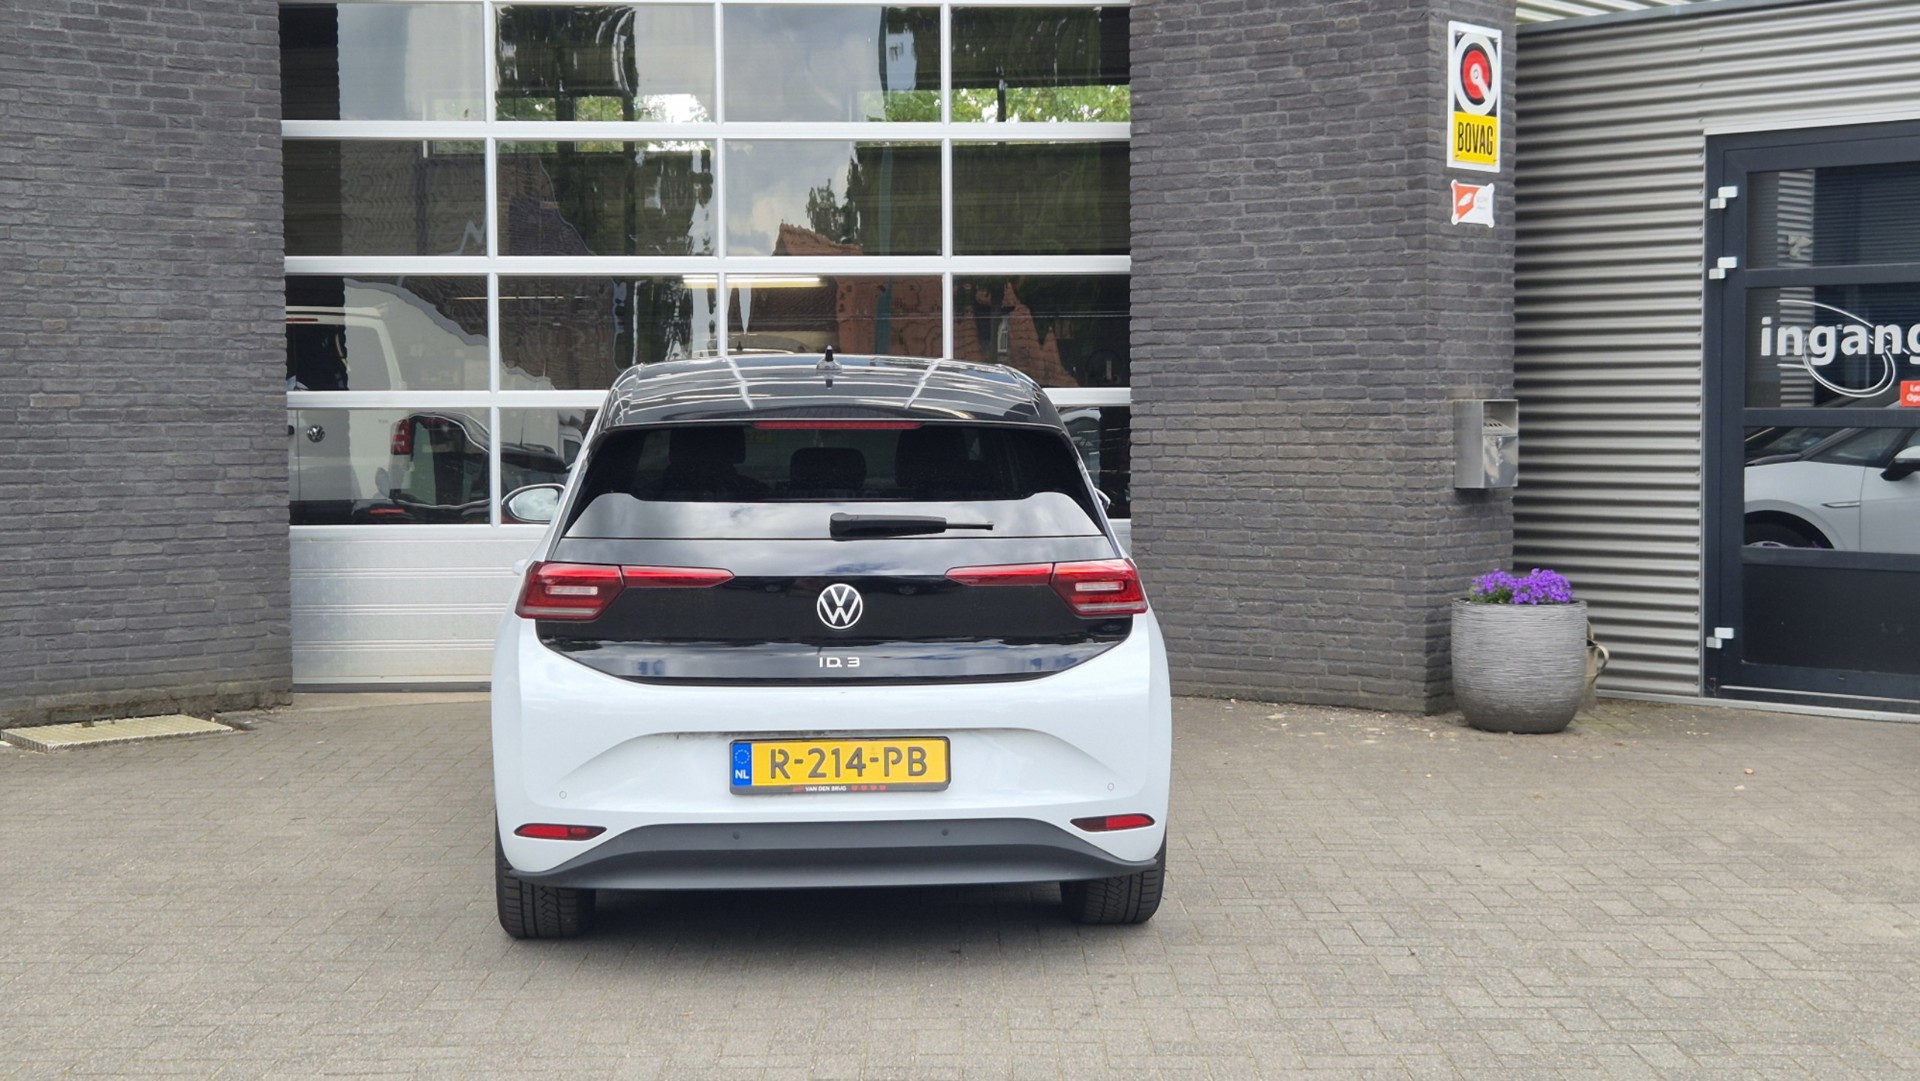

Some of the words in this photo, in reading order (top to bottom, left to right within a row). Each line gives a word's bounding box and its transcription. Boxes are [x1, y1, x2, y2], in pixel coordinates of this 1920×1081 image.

[1457, 121, 1494, 155] BOVAG
[735, 769, 750, 780] NL
[769, 746, 928, 780] R-214-PB
